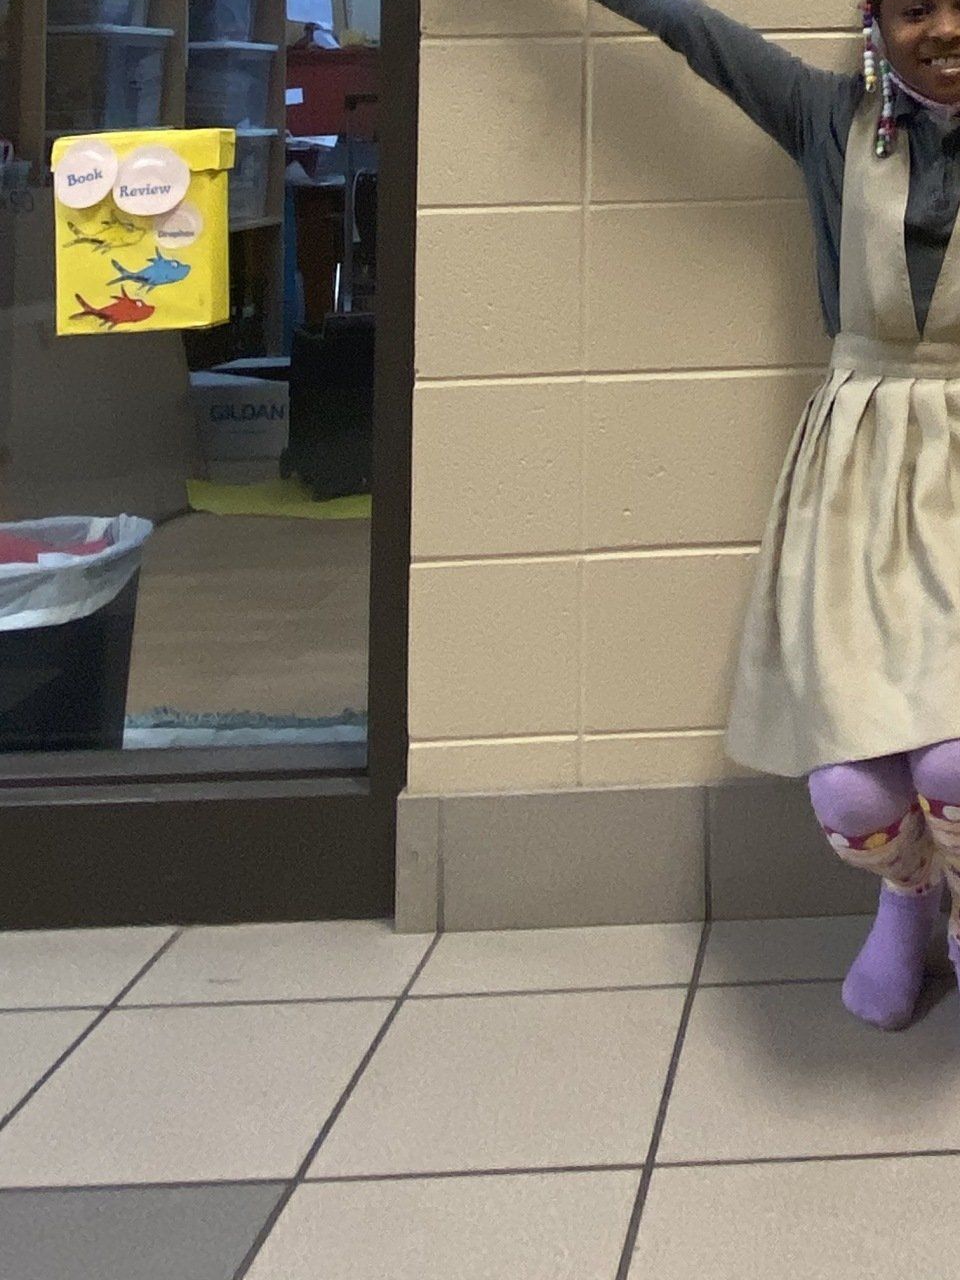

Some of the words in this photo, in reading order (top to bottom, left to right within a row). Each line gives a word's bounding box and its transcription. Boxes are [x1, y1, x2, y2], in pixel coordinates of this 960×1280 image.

[67, 168, 103, 187] Book
[119, 183, 172, 198] Review
[209, 403, 285, 421] GILDAN
